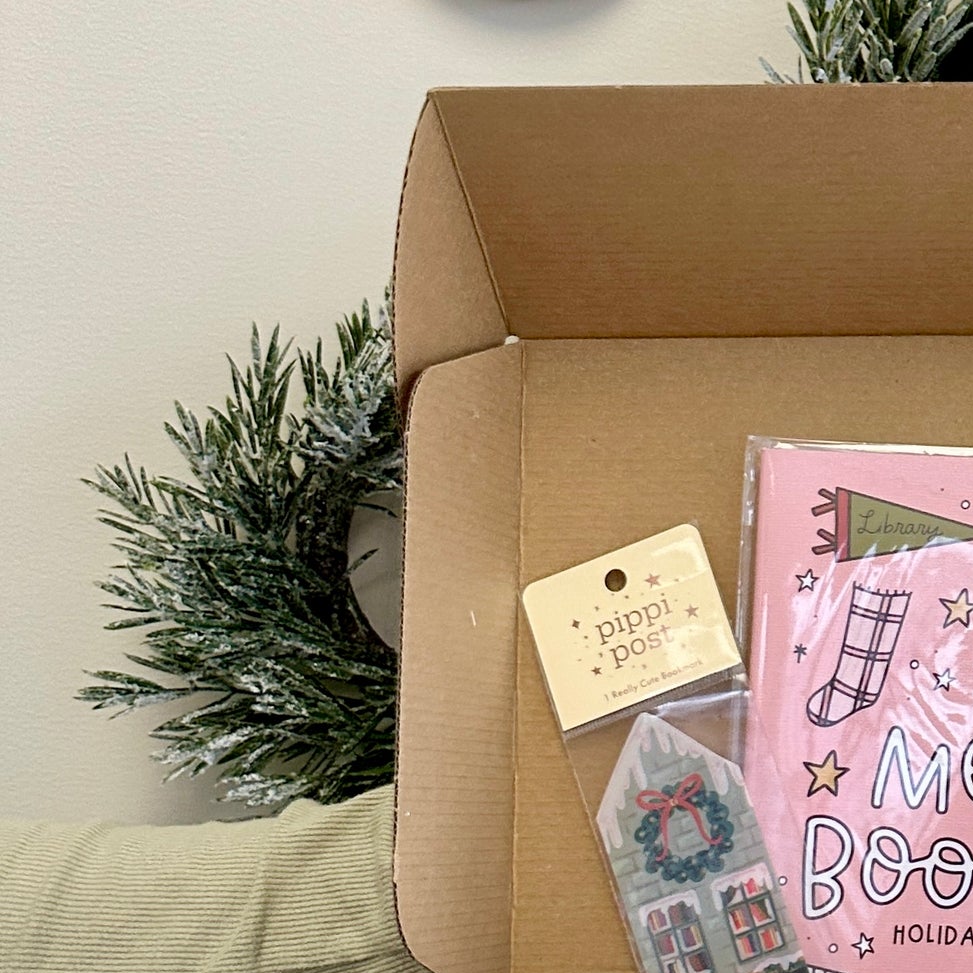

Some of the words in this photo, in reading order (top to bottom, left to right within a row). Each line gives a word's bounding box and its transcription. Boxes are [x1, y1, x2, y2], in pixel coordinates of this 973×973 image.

[857, 509, 944, 541] Library
[595, 593, 672, 645] pippi
[609, 624, 675, 669] post
[612, 683, 638, 698] Really
[640, 677, 660, 688] Cute
[661, 658, 703, 679] Bookmark
